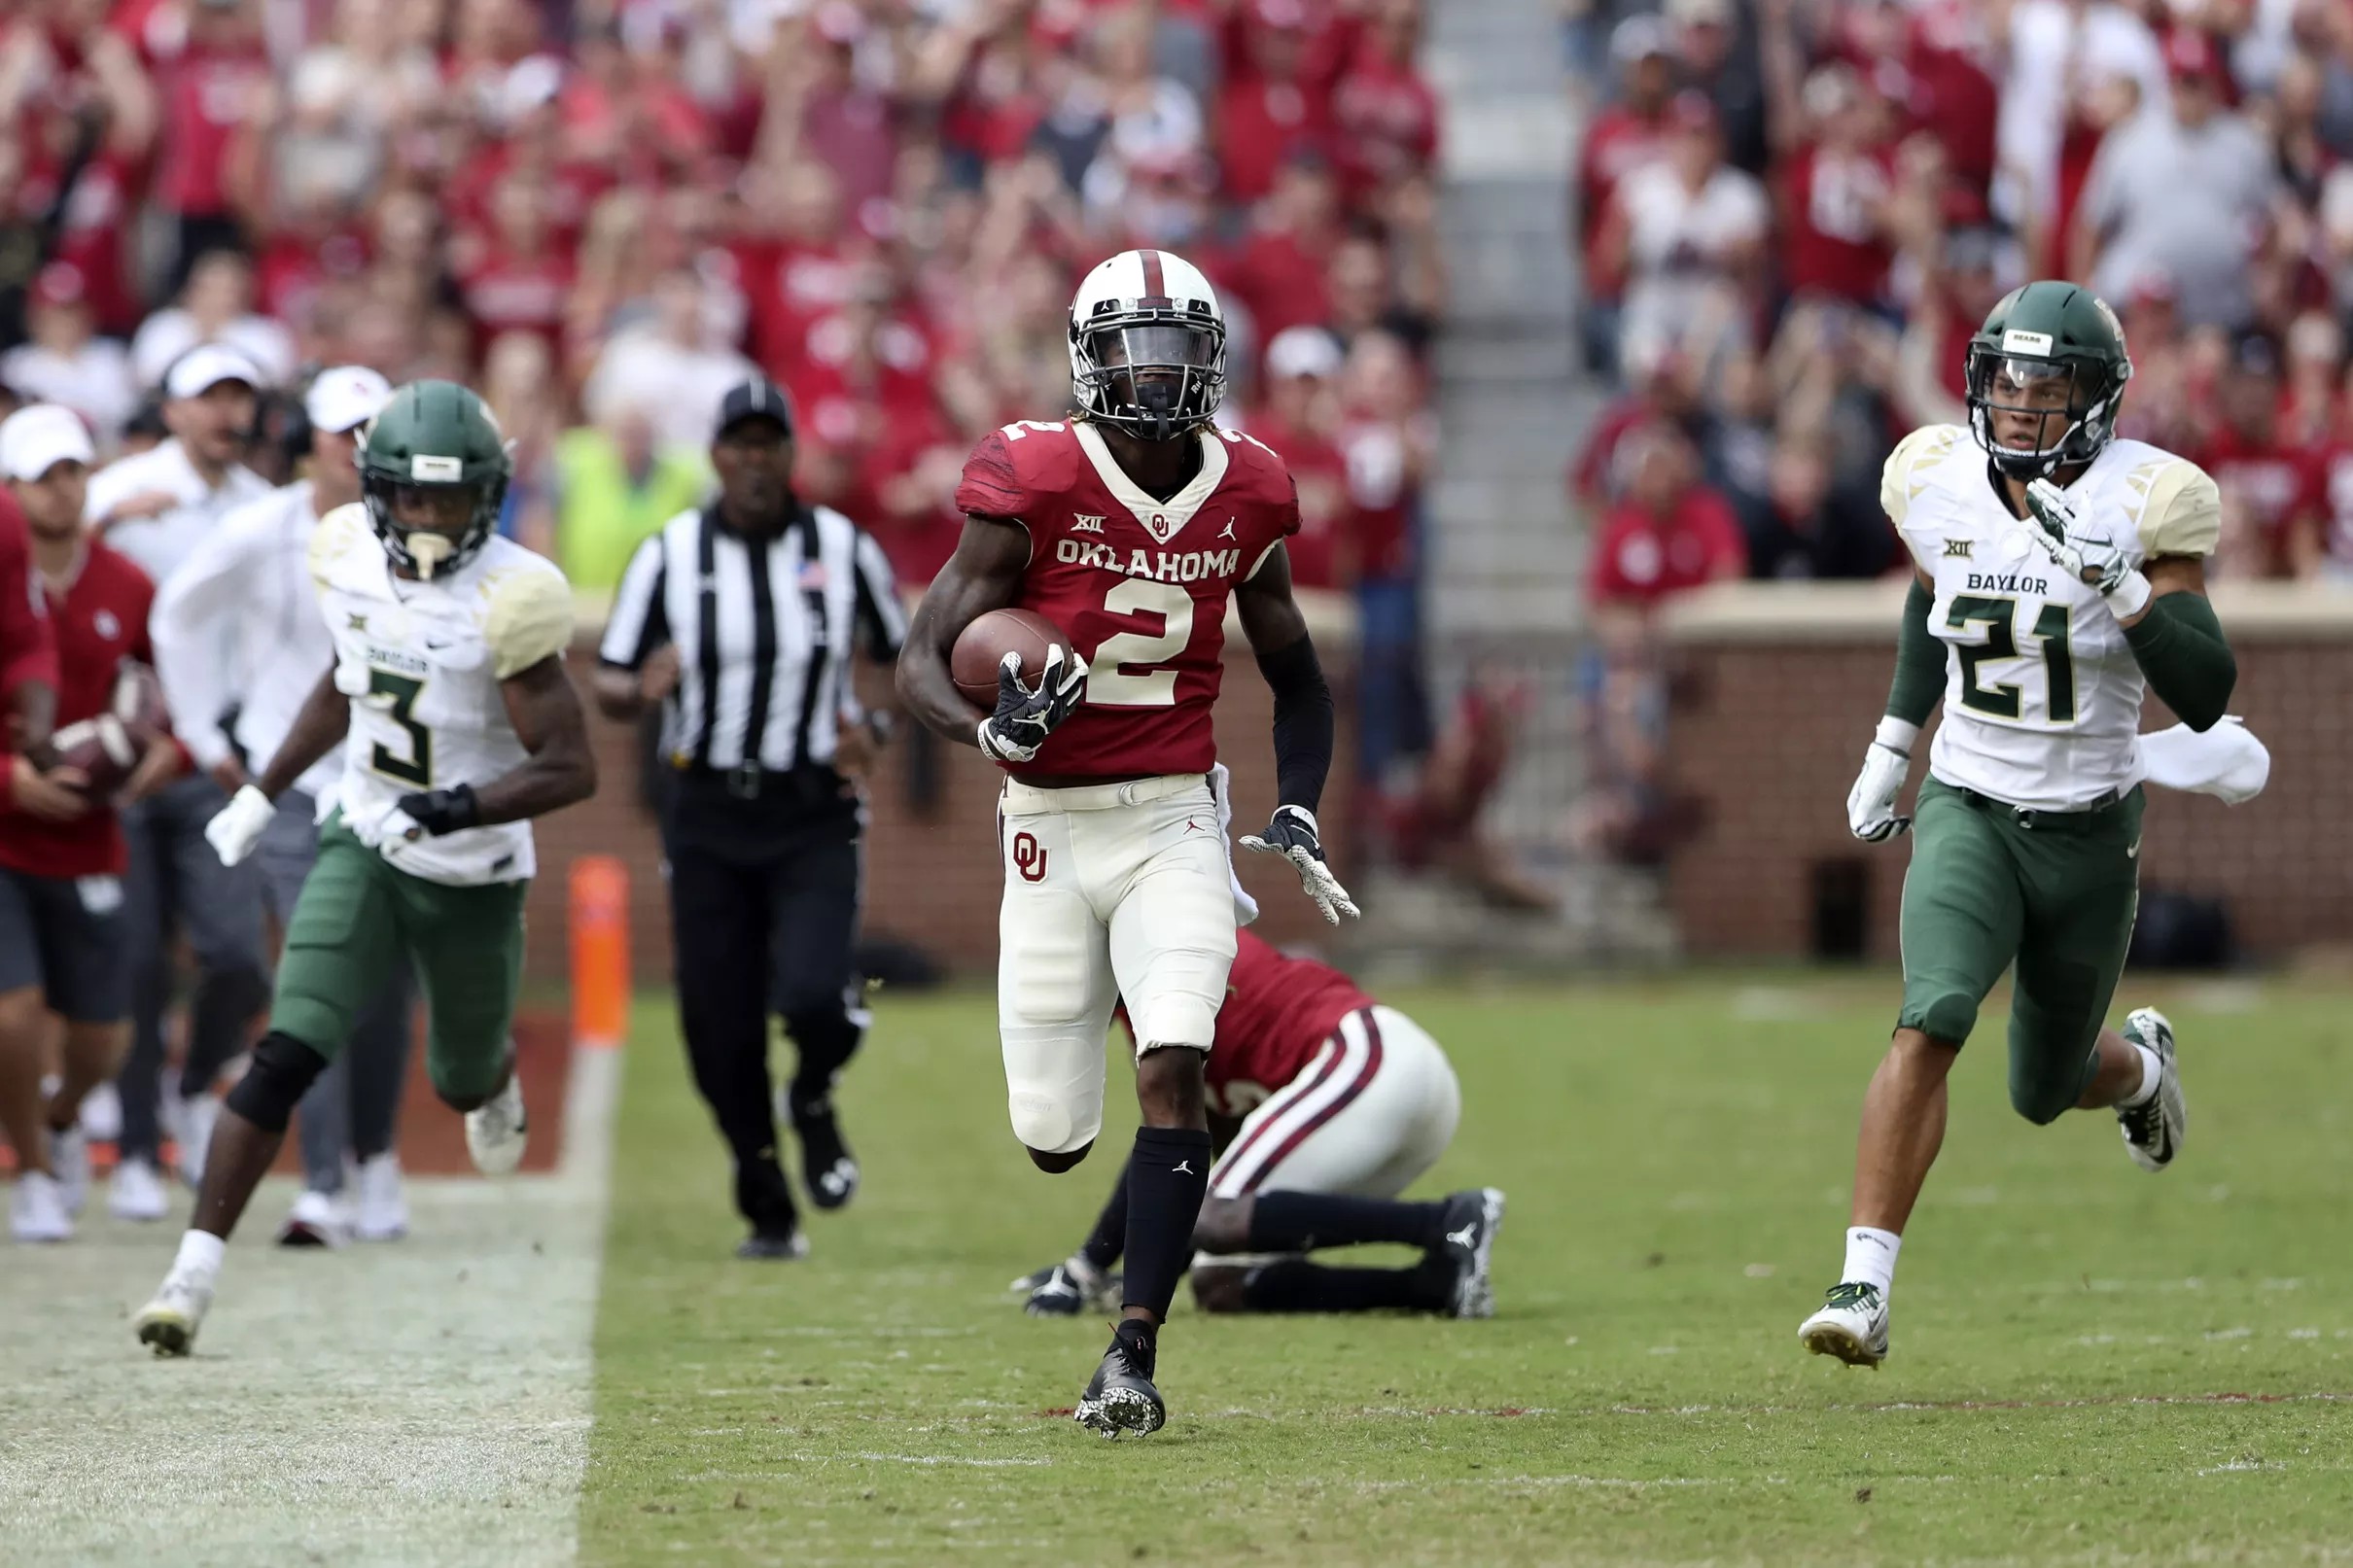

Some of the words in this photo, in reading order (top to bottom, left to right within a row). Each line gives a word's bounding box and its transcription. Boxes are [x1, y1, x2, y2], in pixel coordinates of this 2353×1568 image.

[1071, 512, 1106, 534] XII
[1056, 539, 1241, 582] OKLAHOMA
[1944, 538, 1975, 561] XII
[1967, 573, 2048, 595] BAYLOR
[1086, 577, 1195, 706] 2
[1944, 593, 2078, 725] 21
[369, 664, 433, 791] 3
[1013, 831, 1050, 885] OU
